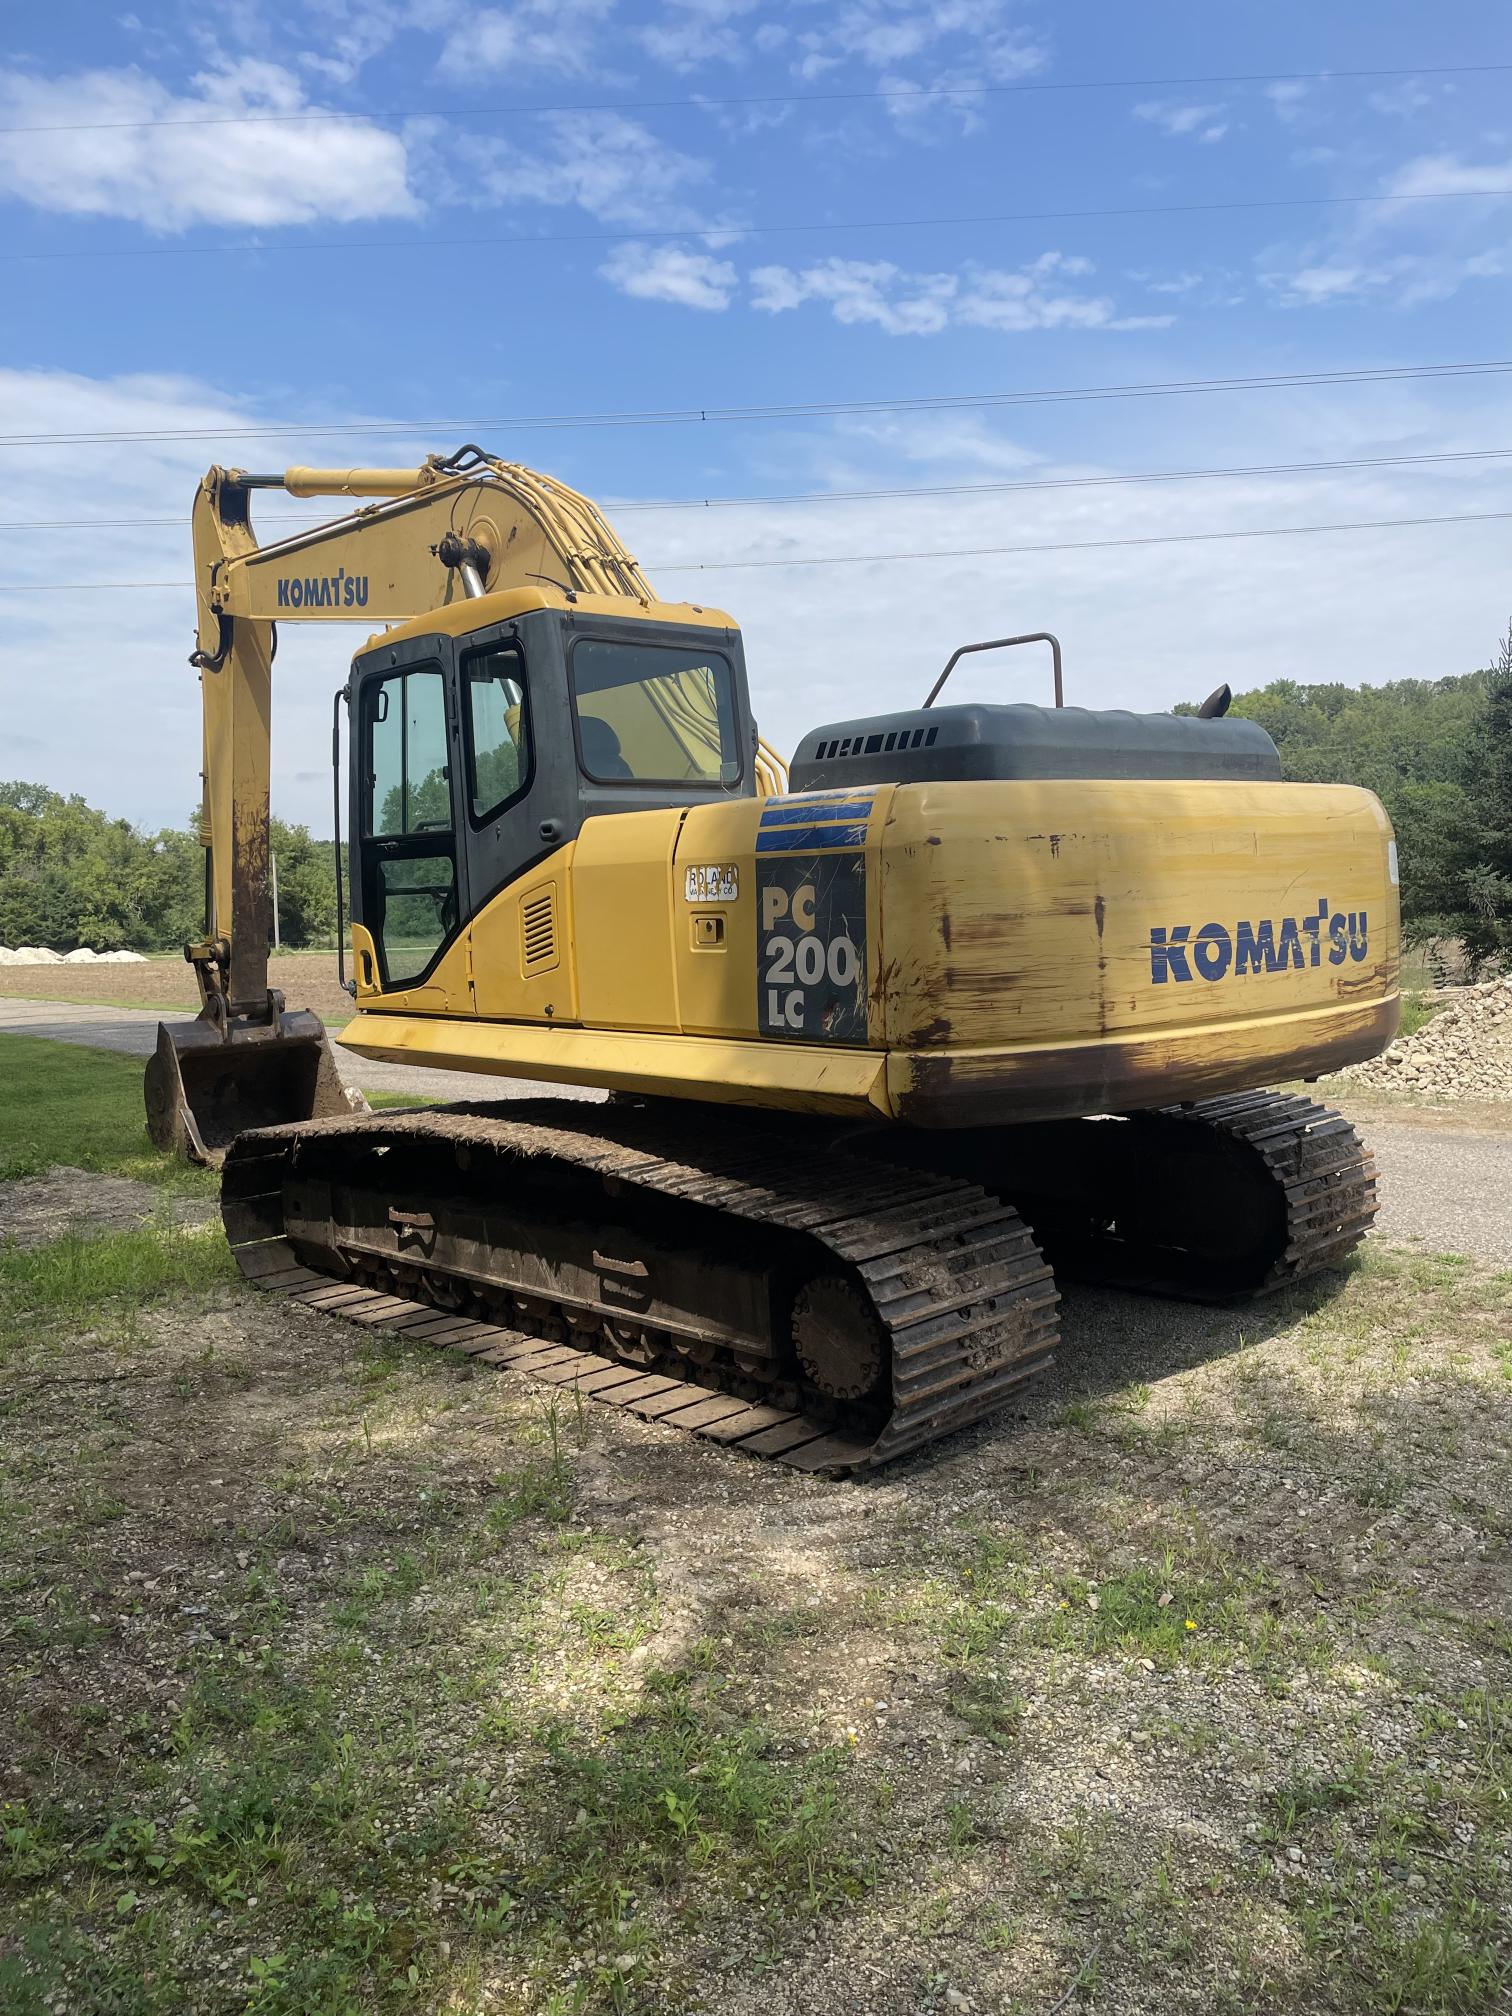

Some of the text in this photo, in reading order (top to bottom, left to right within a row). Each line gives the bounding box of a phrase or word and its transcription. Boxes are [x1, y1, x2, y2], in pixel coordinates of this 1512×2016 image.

[277, 567, 368, 608] KOMATSU
[762, 885, 815, 931] PC
[765, 936, 856, 986] 200
[1150, 898, 1367, 984] KOMATSU
[768, 990, 804, 1028] LC
